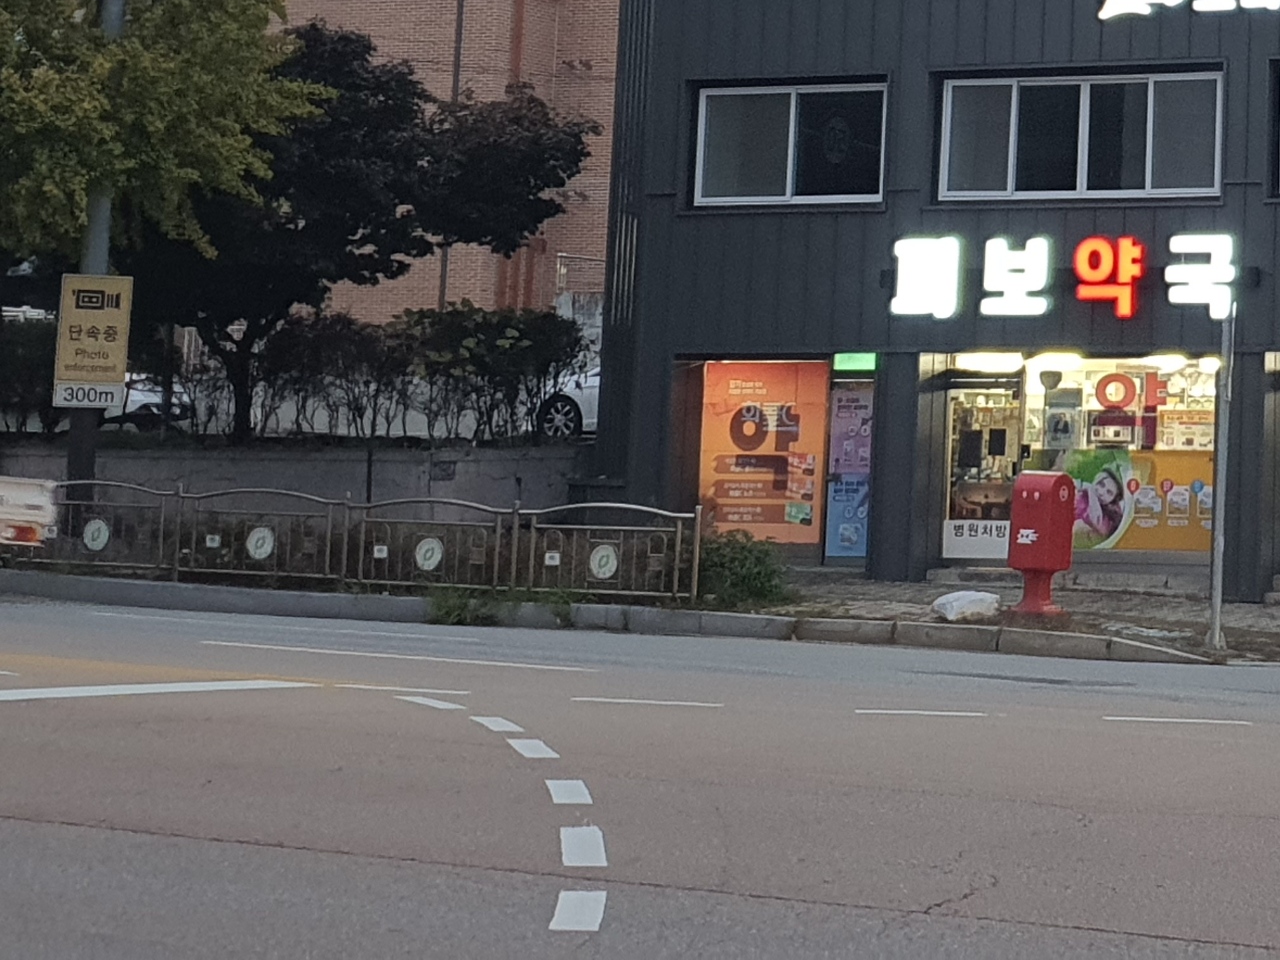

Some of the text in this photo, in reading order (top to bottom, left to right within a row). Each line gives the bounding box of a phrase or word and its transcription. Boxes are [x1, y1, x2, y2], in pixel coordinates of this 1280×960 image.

[69, 325, 118, 343] 단속중
[75, 348, 109, 360] Photo
[63, 387, 115, 403] 300m
[953, 523, 1007, 538] 병원처방
